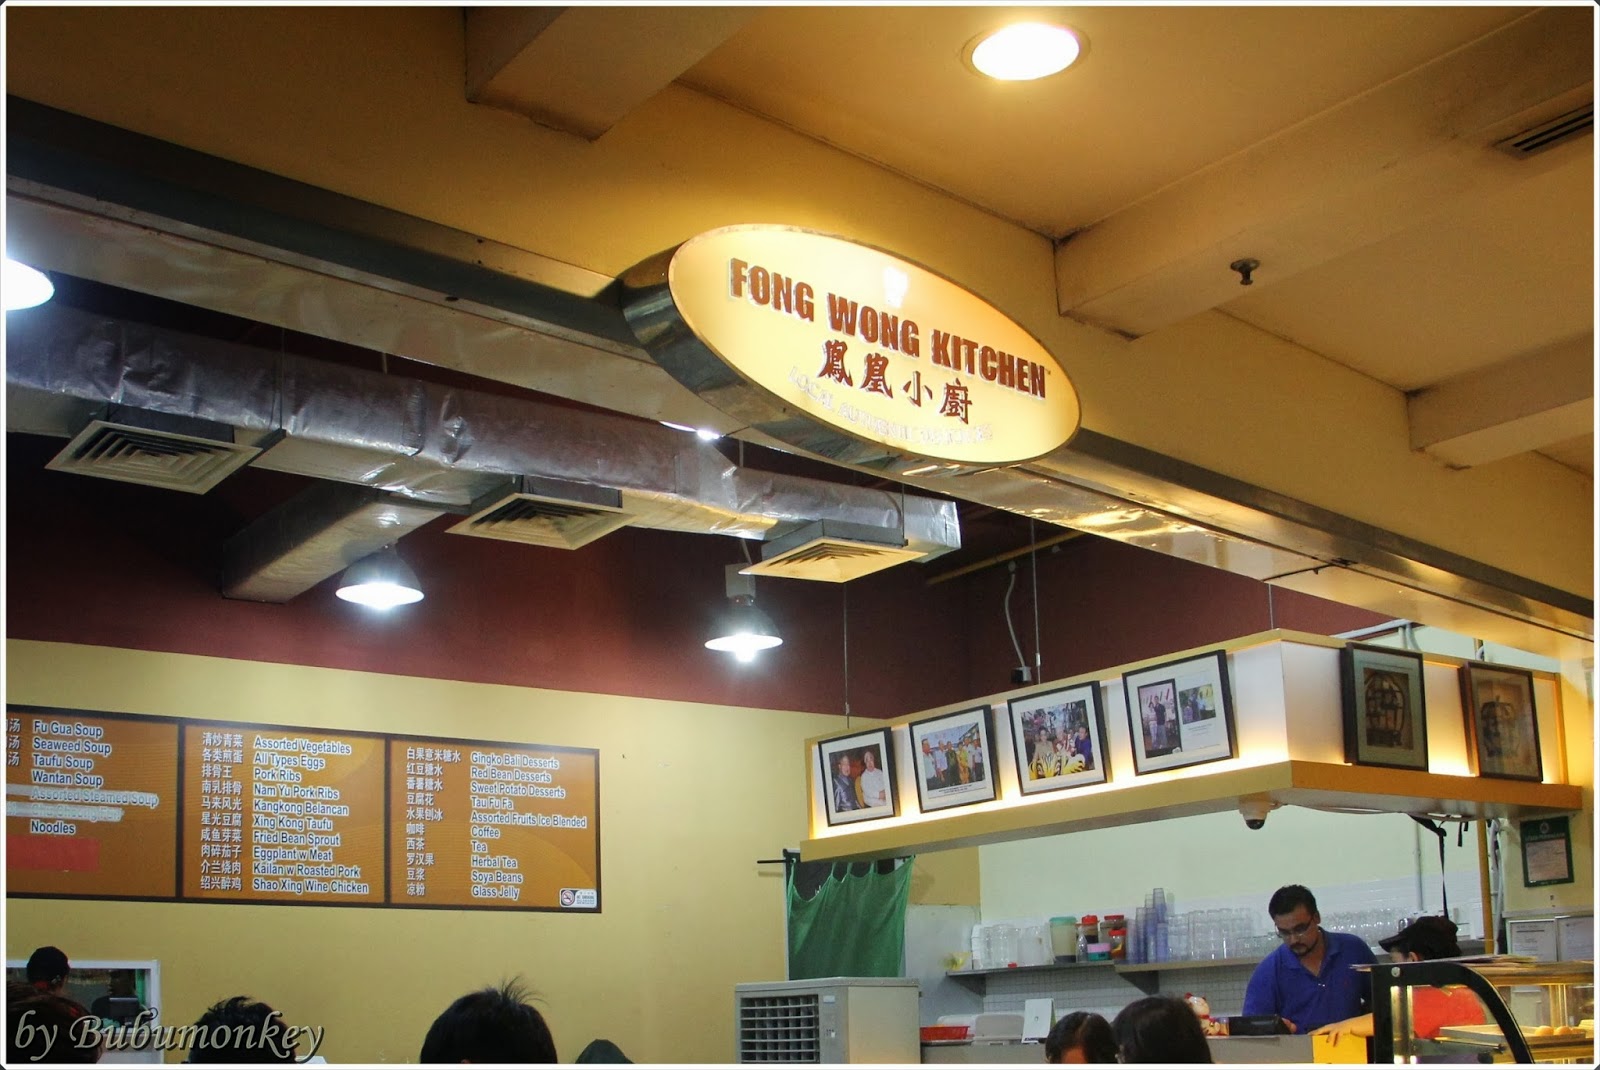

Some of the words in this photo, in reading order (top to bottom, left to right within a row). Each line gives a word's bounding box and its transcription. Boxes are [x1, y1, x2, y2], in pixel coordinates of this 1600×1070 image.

[730, 257, 815, 322] FONG
[827, 292, 920, 358] WONG
[931, 329, 1047, 399] KITCHEN
[818, 339, 973, 424] 鳳凰小廚
[33, 720, 48, 733] Fu
[50, 723, 73, 735] Gua
[75, 723, 103, 738] Soup
[33, 737, 81, 752] Seaweed
[83, 740, 111, 755] Soup
[254, 736, 299, 751] Assorted
[300, 739, 352, 754] Vegetables
[32, 754, 62, 769] Taufu
[65, 756, 93, 770] Soup
[254, 752, 268, 765] All
[270, 753, 299, 768] Types
[301, 755, 325, 769] Eggs
[471, 752, 502, 767] Gingko
[504, 754, 521, 766] Bali
[522, 755, 559, 769] Desserts
[202, 765, 232, 778] 排骨王
[254, 768, 278, 780] Pork
[280, 770, 302, 782] Ribs
[471, 768, 489, 779] Red
[490, 768, 513, 780] Bean
[514, 769, 551, 783] Desserts
[32, 771, 73, 784] Wantan
[74, 773, 103, 788] Soup
[202, 781, 242, 796] 南乳排骨
[254, 784, 276, 797] Nam
[279, 786, 291, 798] Yu
[293, 786, 316, 798] Pork
[318, 787, 340, 800] Ribs
[471, 782, 498, 794] Sweet
[499, 783, 527, 796] Potato
[528, 784, 565, 798] Desserts
[31, 788, 81, 802] Assorted
[83, 790, 129, 805] Steamed
[131, 794, 159, 809] Soup
[201, 797, 242, 811] 马来风光
[471, 796, 488, 808] Tau
[489, 796, 501, 808] Fu
[502, 797, 514, 809] Fa
[254, 799, 302, 815] Kangkong
[305, 802, 348, 815] Belancan
[31, 820, 75, 834] Noodles
[201, 812, 242, 827] 星光豆腐
[253, 815, 276, 830] Xing
[278, 816, 304, 831] Kong
[306, 818, 333, 830] Taufu
[471, 811, 511, 824] Assorted
[512, 813, 537, 826] Fruits
[538, 814, 551, 826] Ice
[553, 813, 587, 828] Blended
[406, 823, 425, 835] 咖啡
[471, 826, 501, 838] Coffee
[253, 831, 279, 844] Fried
[281, 833, 305, 845] Bean
[308, 833, 341, 847] Sprout
[406, 838, 425, 851] 西茶
[471, 841, 488, 852] Tea
[253, 847, 297, 861] Eggplant
[299, 849, 307, 859] w
[309, 849, 333, 861] Meat
[406, 852, 435, 867] 罗汉果
[471, 855, 500, 868] Herbal
[502, 856, 517, 868] Tea
[201, 860, 241, 875] 介兰烧肉
[253, 863, 284, 876] Kailan
[286, 865, 294, 875] w
[297, 864, 336, 877] Roasted
[337, 866, 360, 878] Pork
[406, 867, 425, 881] 豆浆
[200, 877, 242, 891] 绍兴醉鸡
[471, 870, 494, 884] Soya
[495, 871, 523, 884] Beans
[253, 879, 279, 890] Shao
[280, 879, 304, 894] Xing
[305, 880, 329, 892] Wine
[331, 881, 369, 893] Chicken
[471, 885, 497, 897] Glass
[499, 886, 520, 900] Jelly
